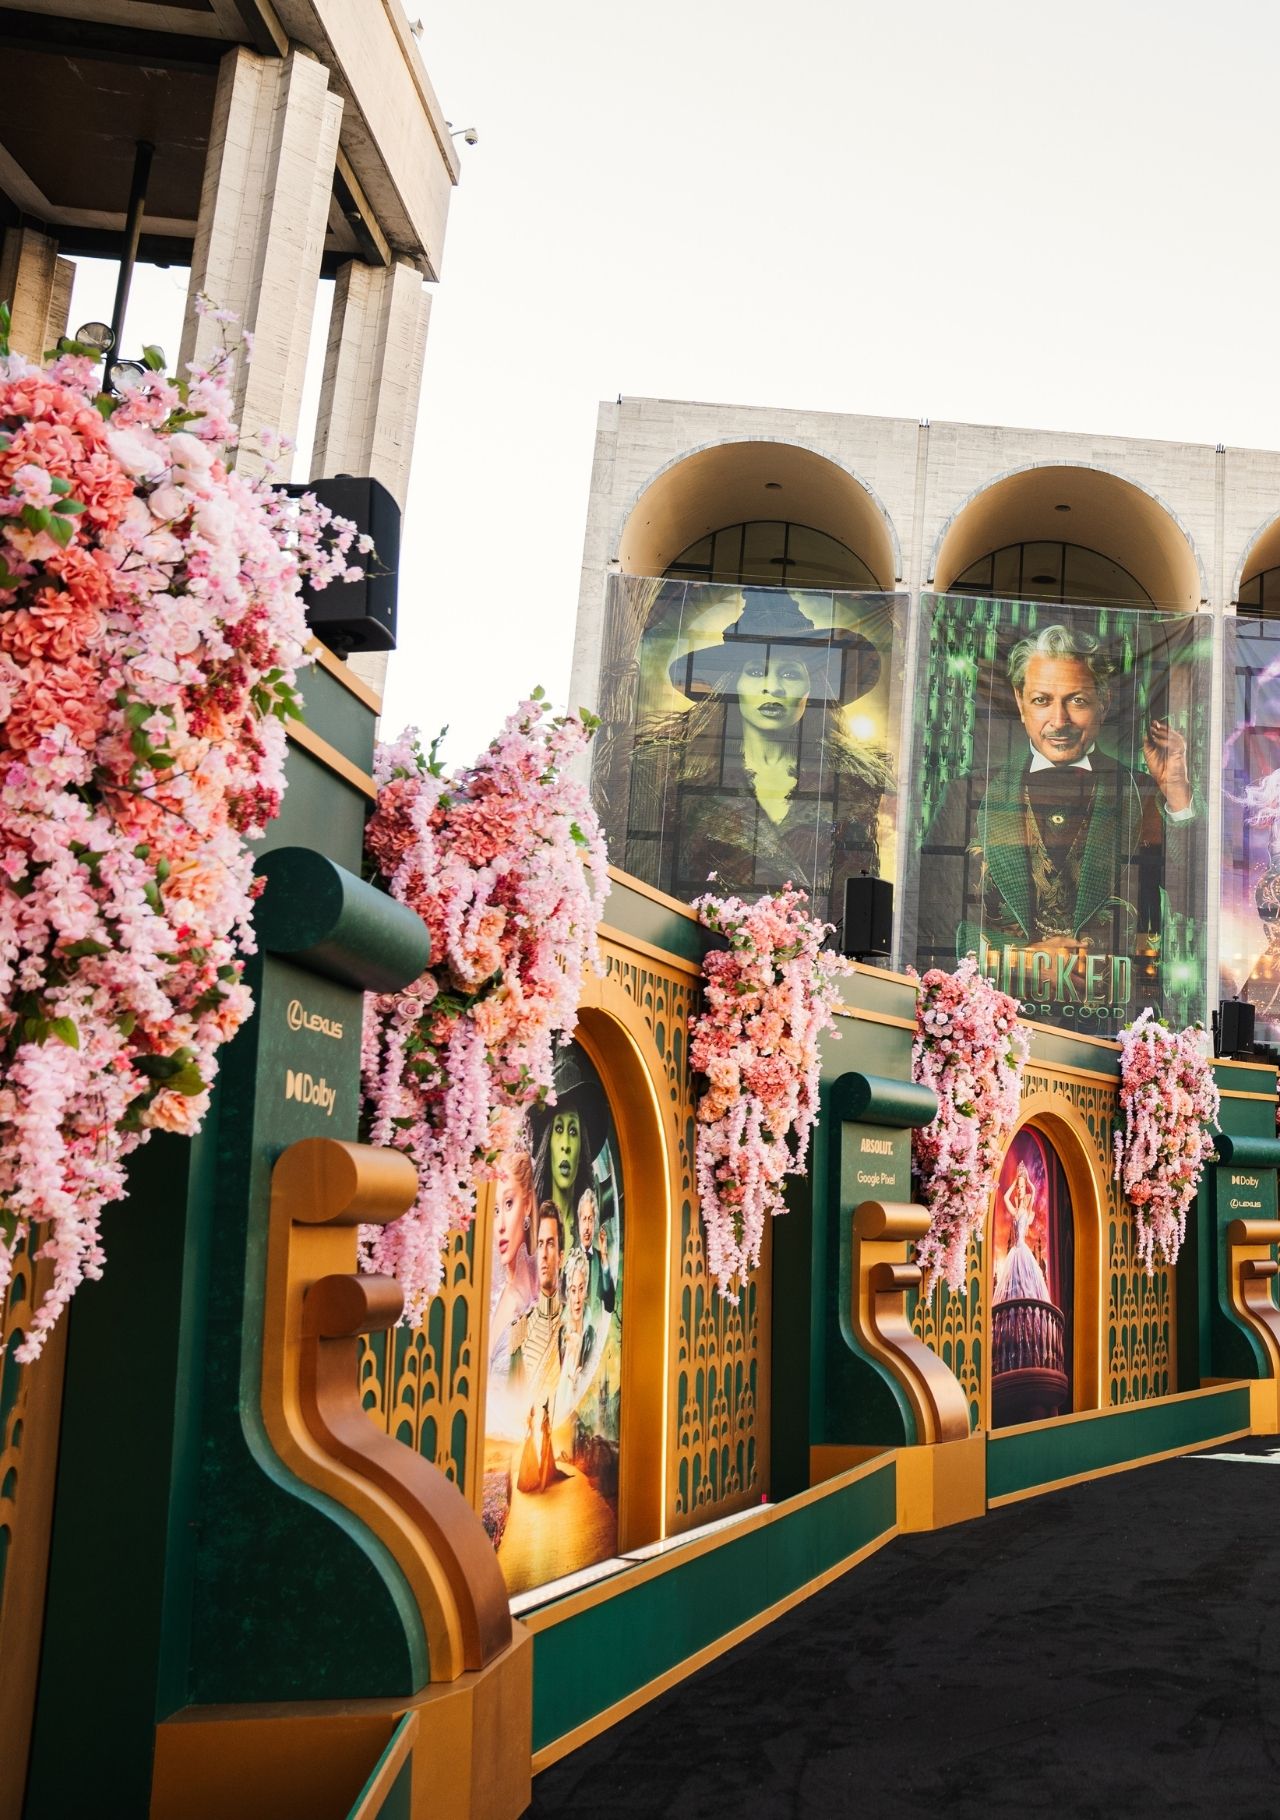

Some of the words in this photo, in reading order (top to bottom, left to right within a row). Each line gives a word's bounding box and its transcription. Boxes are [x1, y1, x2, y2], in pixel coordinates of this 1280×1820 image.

[979, 933, 1132, 1005] WICKED
[1021, 1003, 1053, 1016] OR
[1062, 1005, 1125, 1018] GOOD
[303, 1011, 343, 1039] LEXUS
[303, 1076, 336, 1116] Dolby
[857, 1170, 880, 1187] Google
[880, 1172, 896, 1185] Pixel
[1240, 1175, 1259, 1188] Dolby
[1238, 1200, 1261, 1208] LEXUS
